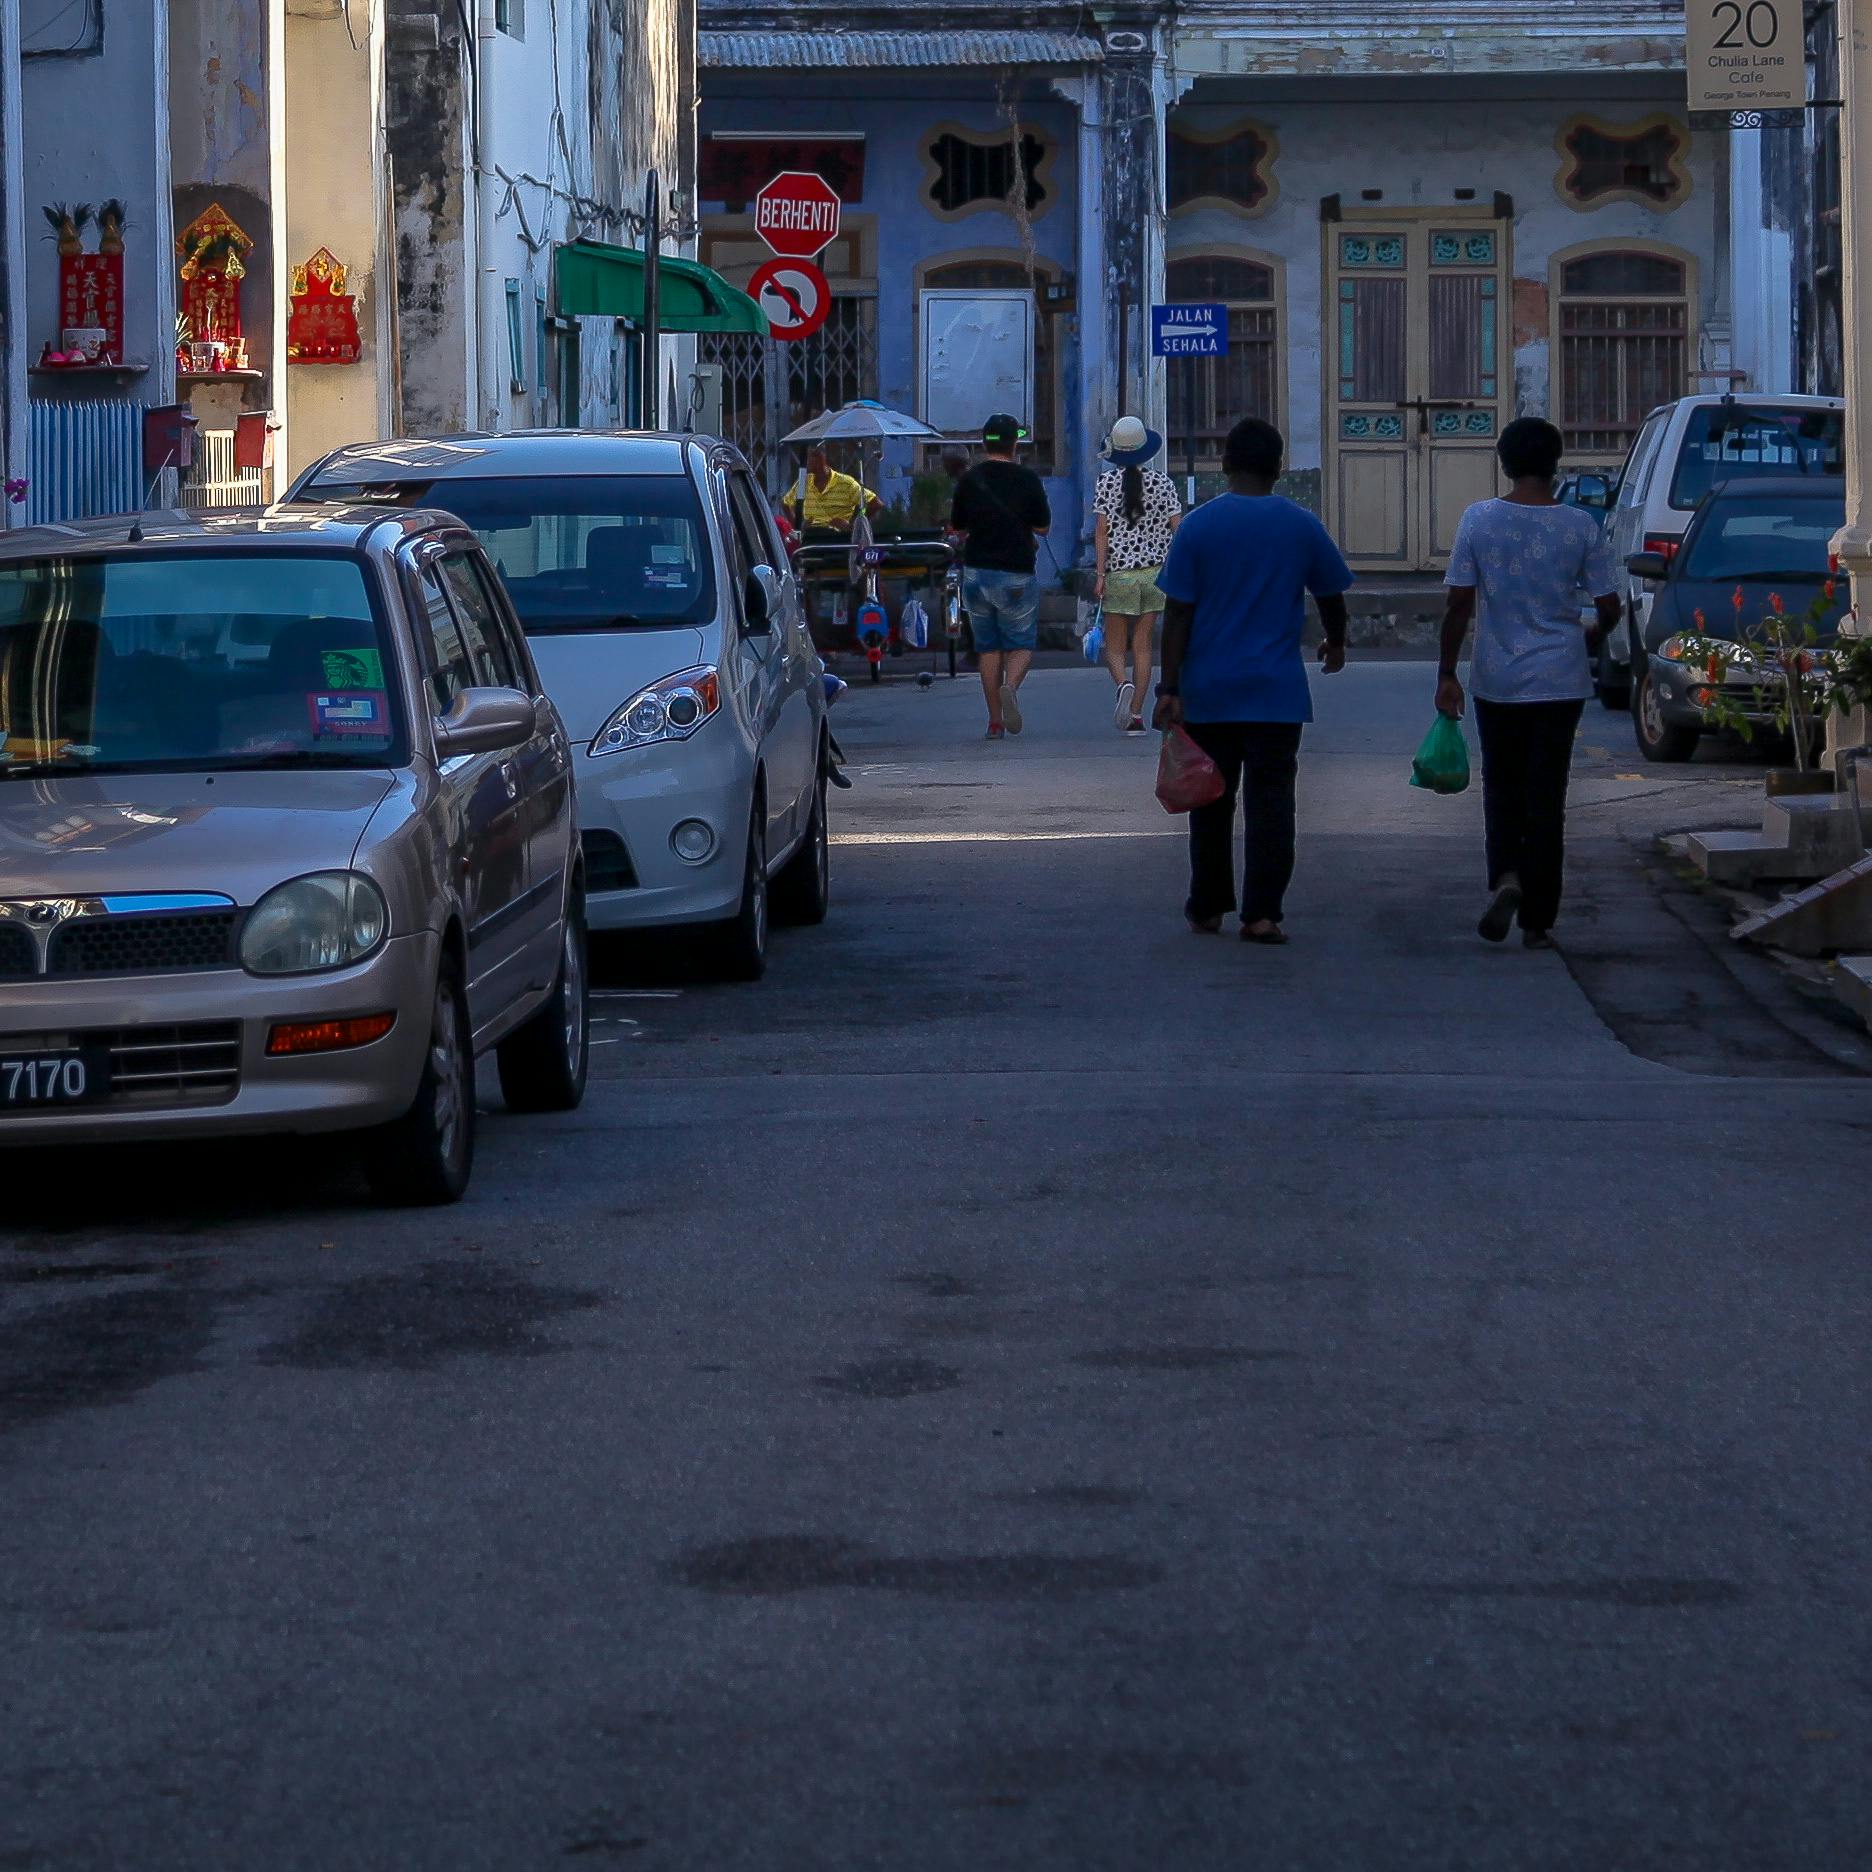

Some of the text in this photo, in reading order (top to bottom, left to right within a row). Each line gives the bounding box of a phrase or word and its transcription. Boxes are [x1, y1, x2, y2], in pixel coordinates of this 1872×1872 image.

[1711, 0, 1778, 49] 20
[1707, 54, 1785, 68] Chulia Lane
[1728, 71, 1764, 84] Cafe
[1703, 89, 1791, 101] George Town Penang
[760, 197, 835, 232] BERHENTI
[1167, 308, 1213, 323] JALAN
[1163, 338, 1219, 353] SEHALA
[1, 1059, 86, 1101] 7170
